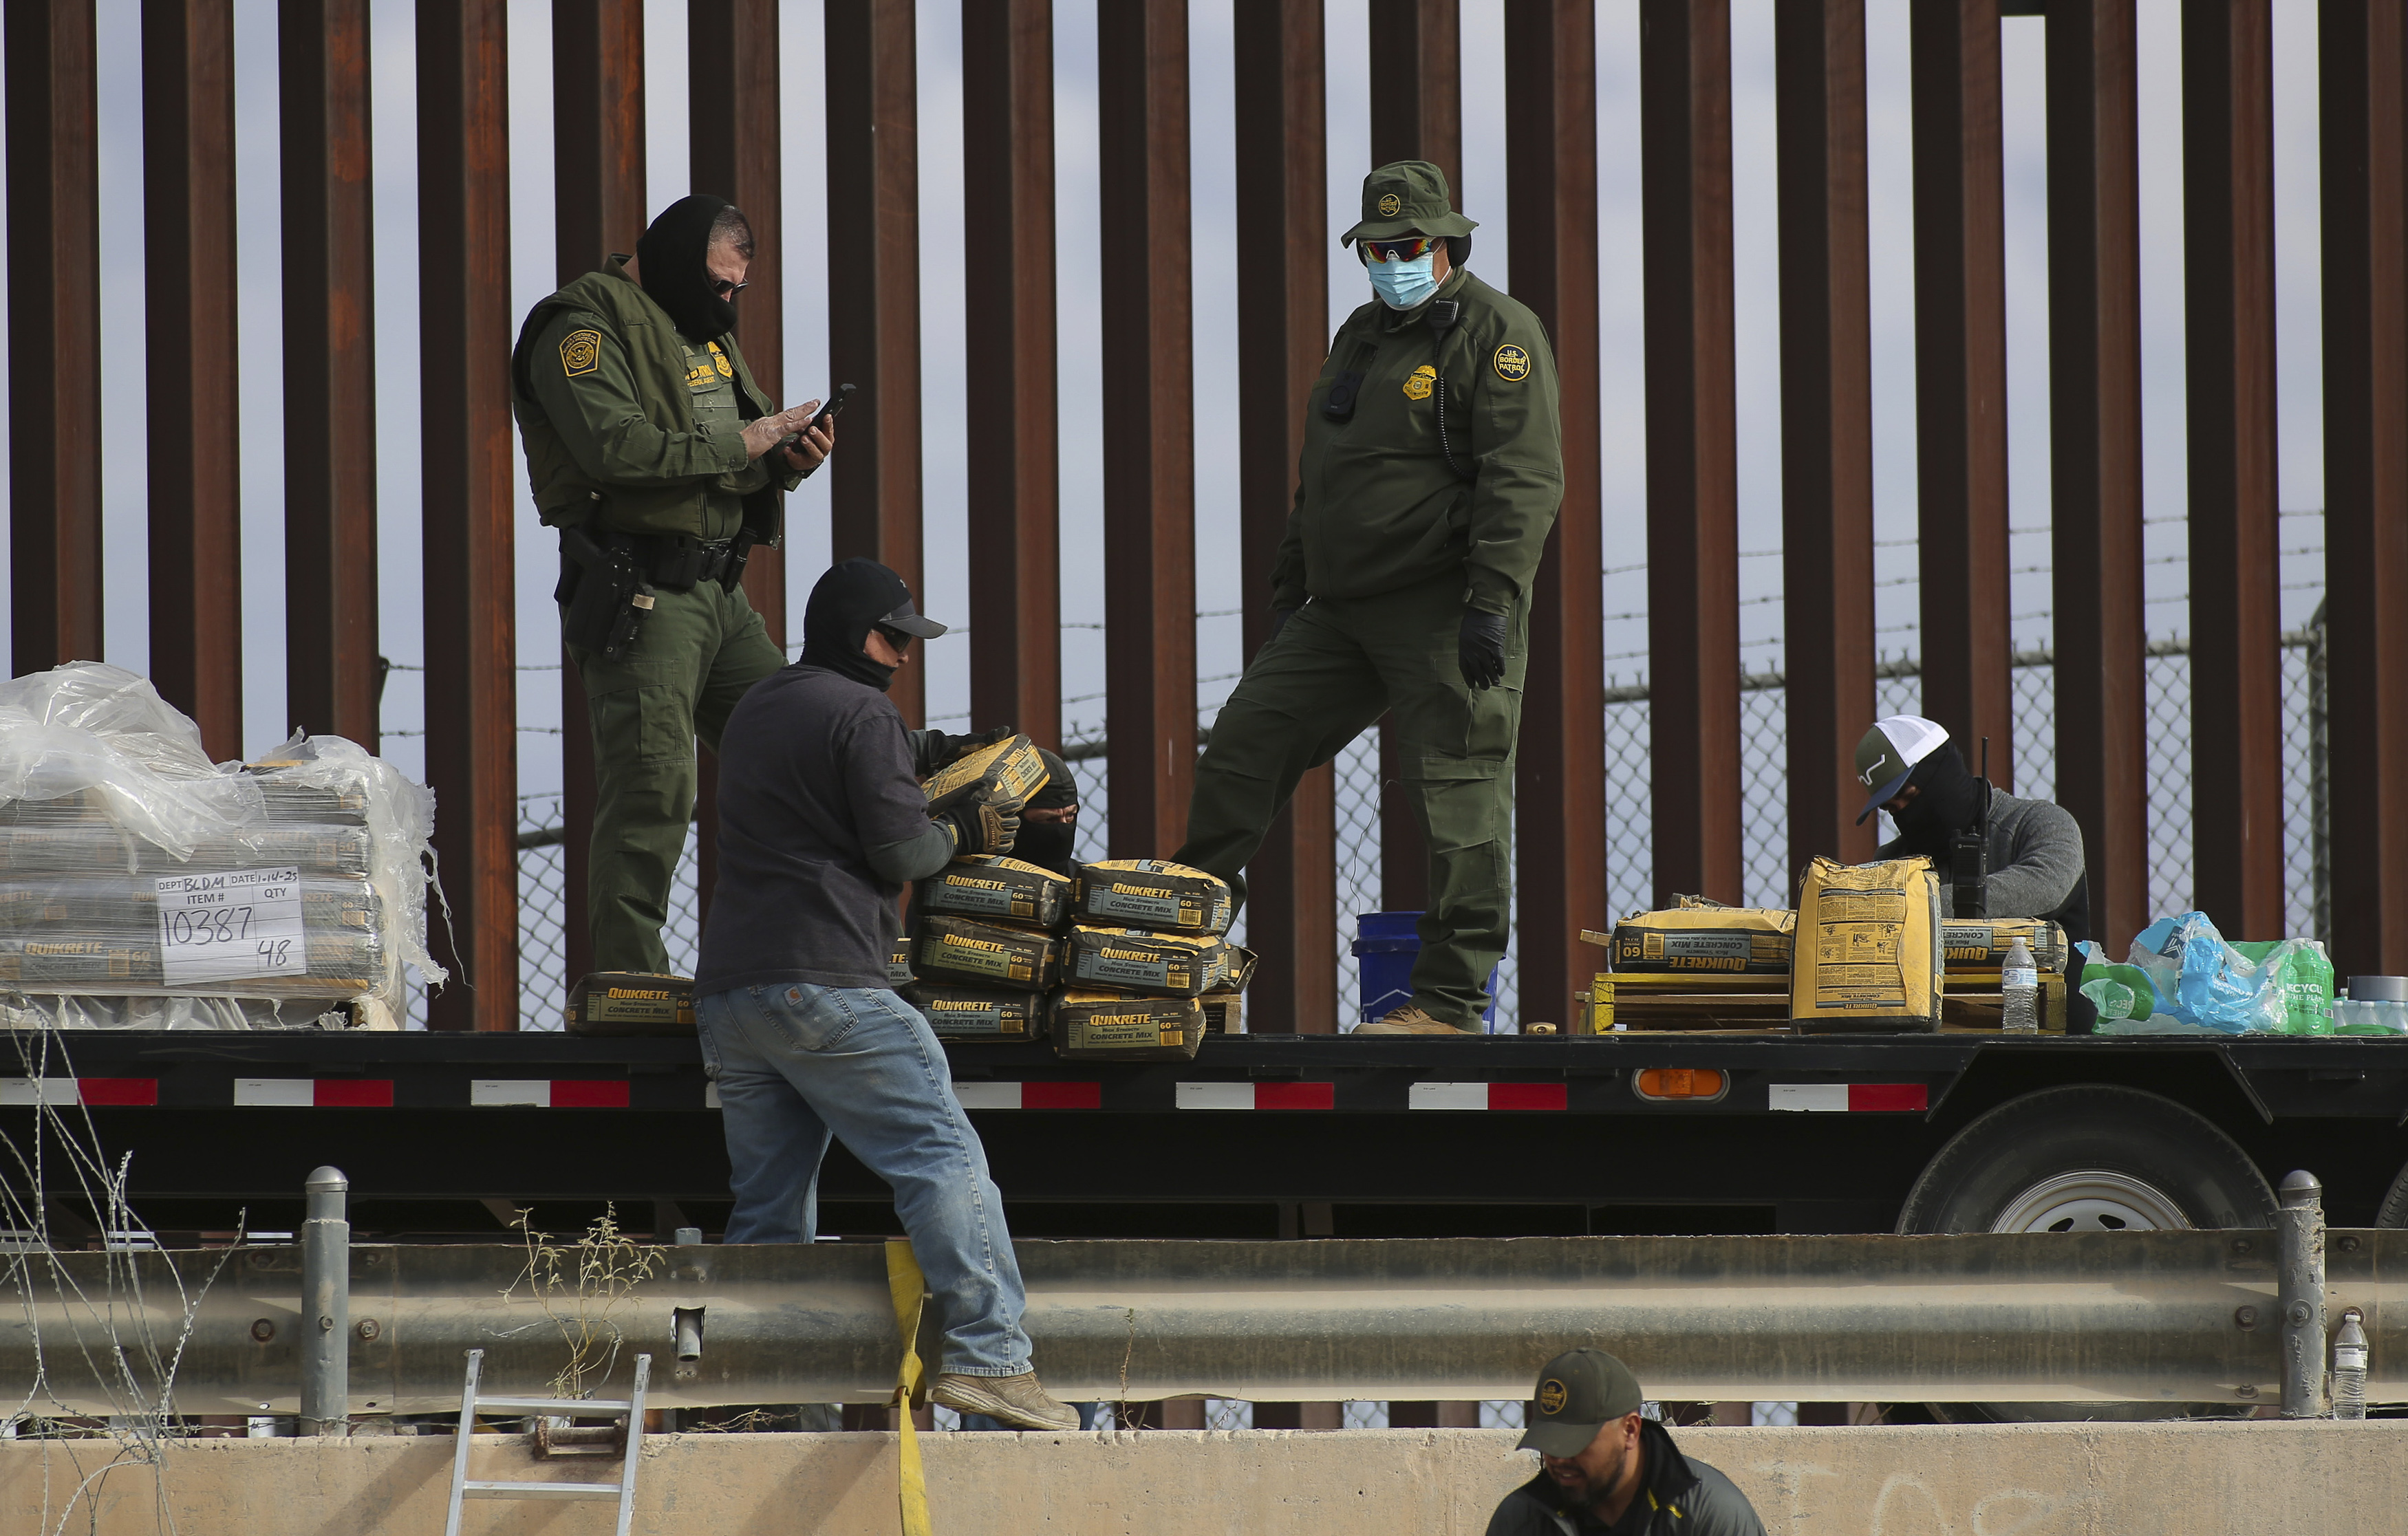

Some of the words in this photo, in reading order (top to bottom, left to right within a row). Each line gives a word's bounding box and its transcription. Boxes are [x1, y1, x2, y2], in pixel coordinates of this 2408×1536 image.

[1500, 356, 1526, 365] BORDER
[1499, 363, 1525, 371] PATROL
[158, 880, 182, 890] DEPT
[231, 874, 256, 884] DATE
[945, 874, 1007, 891] QUIKRETE
[187, 894, 215, 905] ITEM
[217, 893, 225, 902] #
[264, 887, 287, 899] QTY
[1112, 883, 1173, 899] QUIKRETE
[944, 892, 985, 903] CONCRETE
[1110, 900, 1153, 911] CONCRETE
[164, 907, 252, 947] 10387
[25, 942, 103, 956] QUIKRETE
[943, 933, 1005, 953] QUIKRETE
[1671, 940, 1691, 949] MIX
[1693, 941, 1743, 949] CONCRETE
[132, 951, 151, 962] 60
[258, 939, 292, 967] 48
[1099, 947, 1161, 963] QUIKRETE
[1623, 947, 1641, 958] 60
[941, 951, 984, 965] CONCRETE
[985, 959, 1003, 968] MIX
[1668, 956, 1747, 971] QUIKRETE
[1099, 965, 1141, 975] CONCRETE
[608, 987, 670, 1000] QUIKRETE
[2286, 983, 2323, 995] RECYCLE
[2290, 993, 2304, 1001] THE
[608, 1006, 651, 1014] CONCRETE
[932, 999, 993, 1011] QUIKRETE
[1089, 1013, 1151, 1026] QUIKRETE
